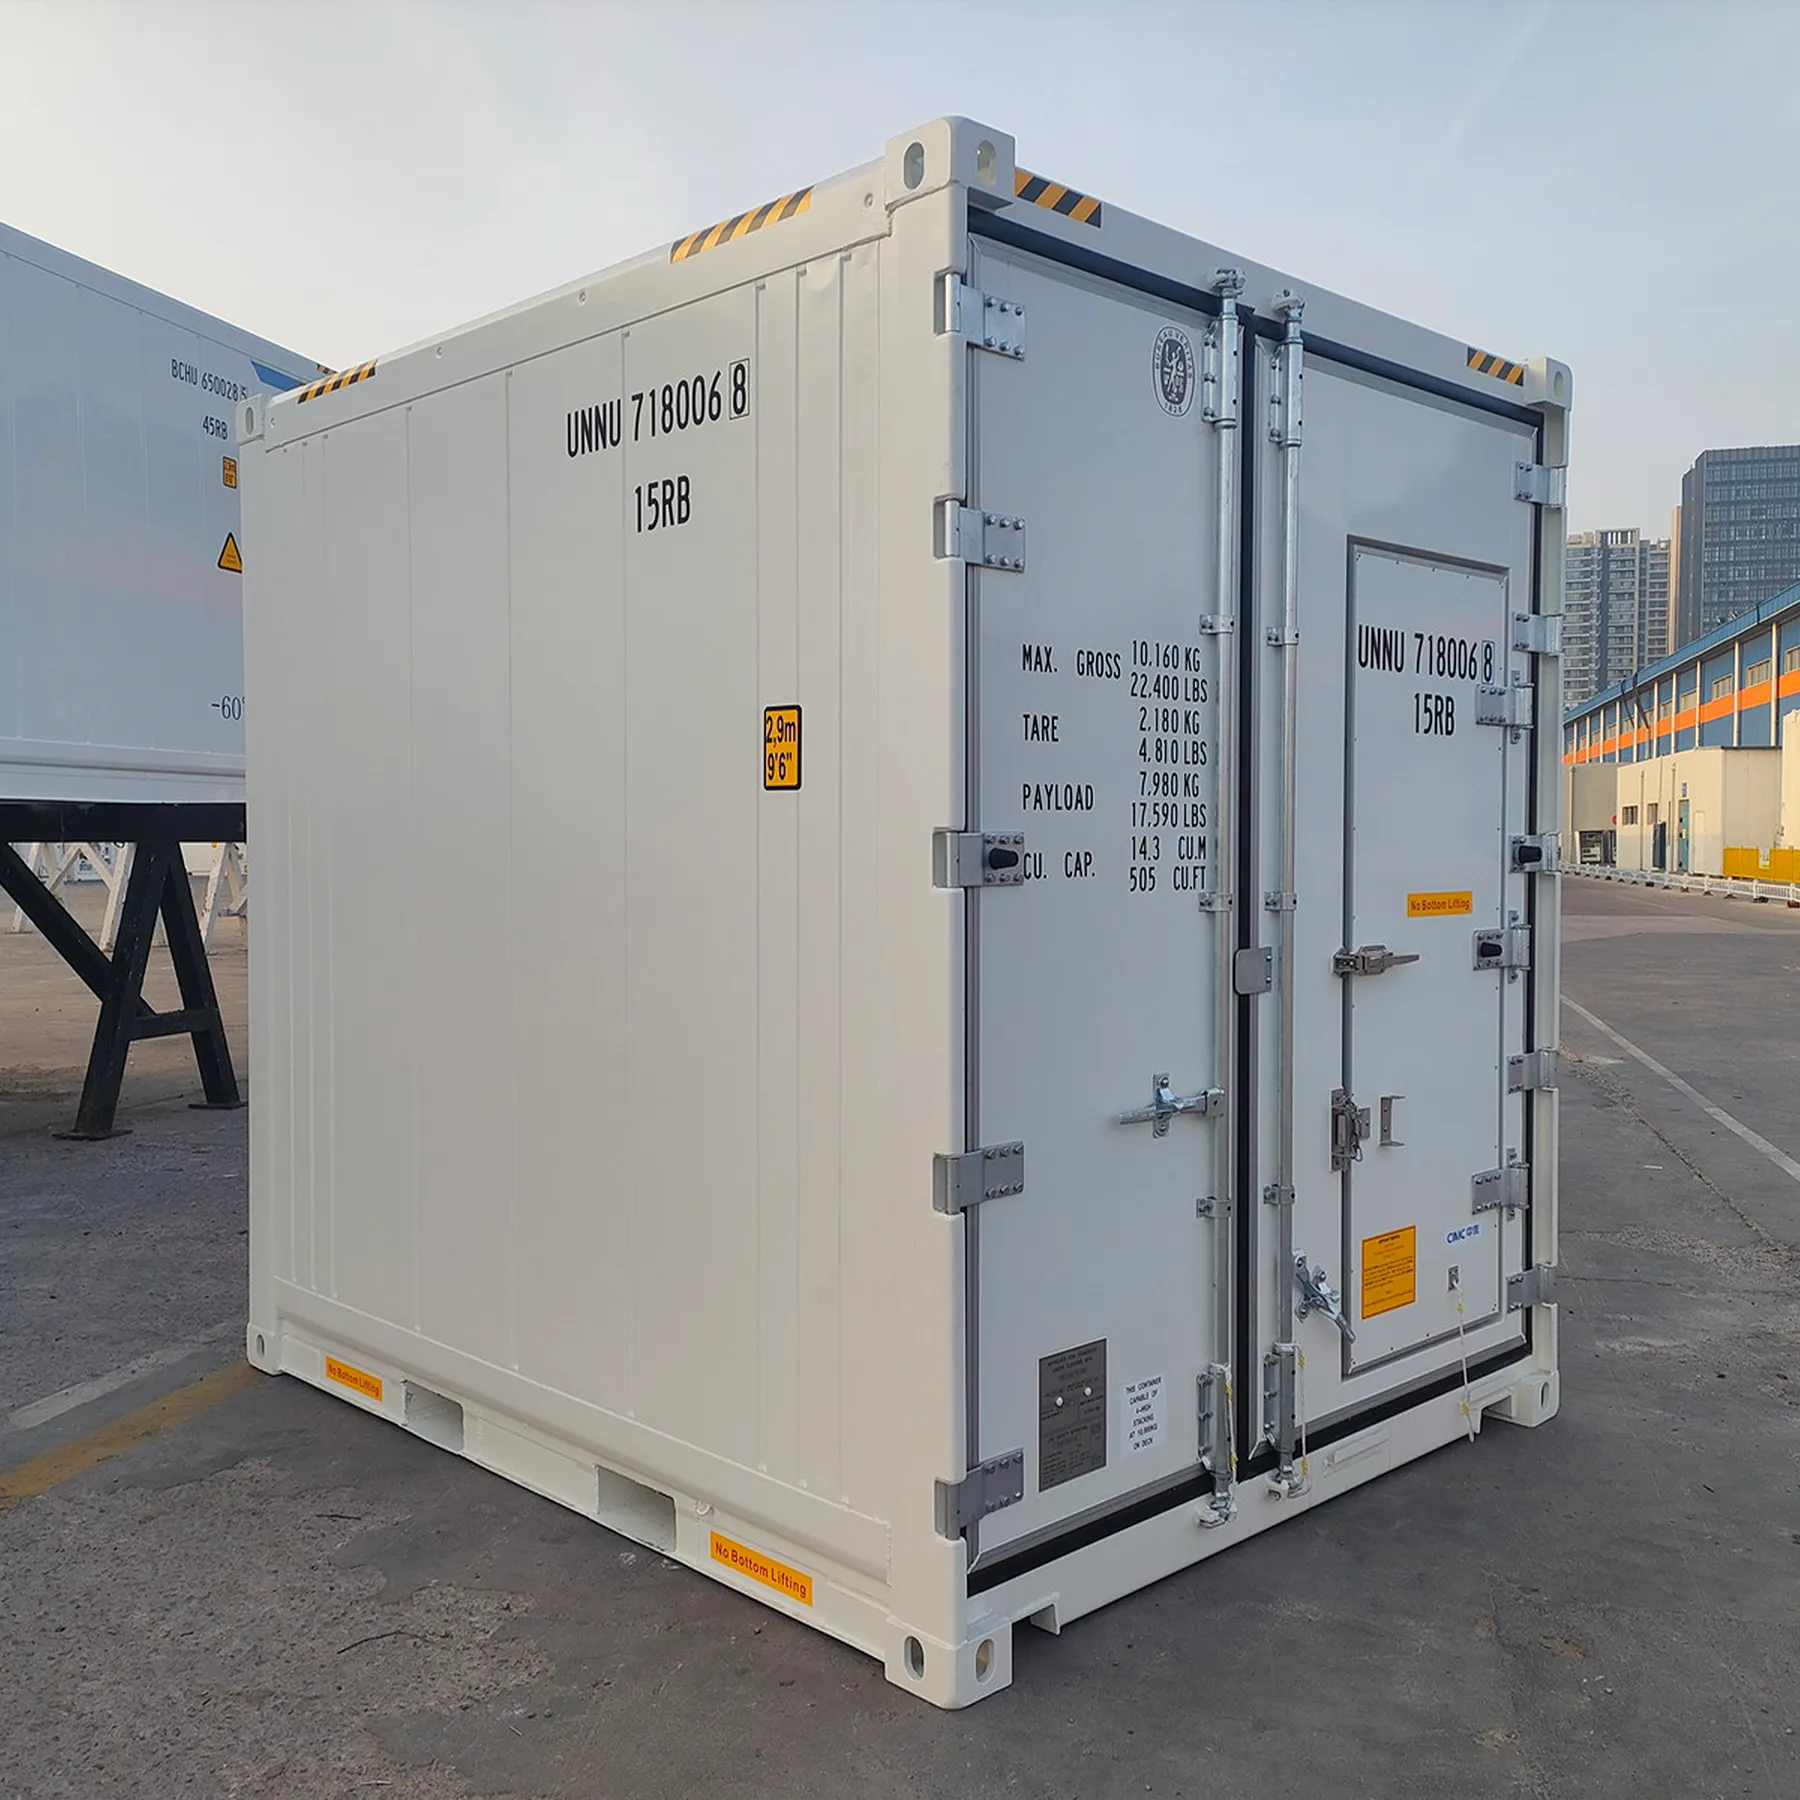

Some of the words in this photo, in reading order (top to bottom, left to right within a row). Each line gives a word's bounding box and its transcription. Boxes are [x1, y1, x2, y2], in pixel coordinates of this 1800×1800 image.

[172, 359, 198, 386] BCHU
[202, 372, 239, 402] 650028
[202, 415, 228, 441] 45RB
[567, 398, 622, 458] UNNU
[631, 370, 722, 442] 718006
[732, 363, 747, 415] 8
[635, 474, 691, 533] 15RB
[1021, 643, 1058, 673] MAX.
[1076, 649, 1121, 680] GROSS
[1184, 646, 1200, 673] KG
[1358, 624, 1405, 673] UNNU
[1414, 632, 1478, 681] 718006
[1483, 643, 1493, 682] 8
[1184, 677, 1208, 703] LBS
[1022, 713, 1060, 742] TARE
[1184, 710, 1200, 735] KG
[1414, 692, 1455, 736] 15RB
[1183, 740, 1207, 766] LBS
[1022, 783, 1094, 811] PAYLOAD
[1183, 773, 1200, 798] KG
[1183, 803, 1207, 828] LBS
[1023, 853, 1048, 880] CU.
[1064, 851, 1096, 878] CAP.
[1131, 835, 1160, 861] 14.3
[1129, 866, 1156, 892] 505
[1410, 899, 1421, 911] No
[1421, 899, 1447, 911] Bottom
[1448, 897, 1470, 912] Lifting
[715, 1541, 730, 1559] No
[731, 1549, 769, 1578] Bottom
[771, 1568, 806, 1599] Lifting
